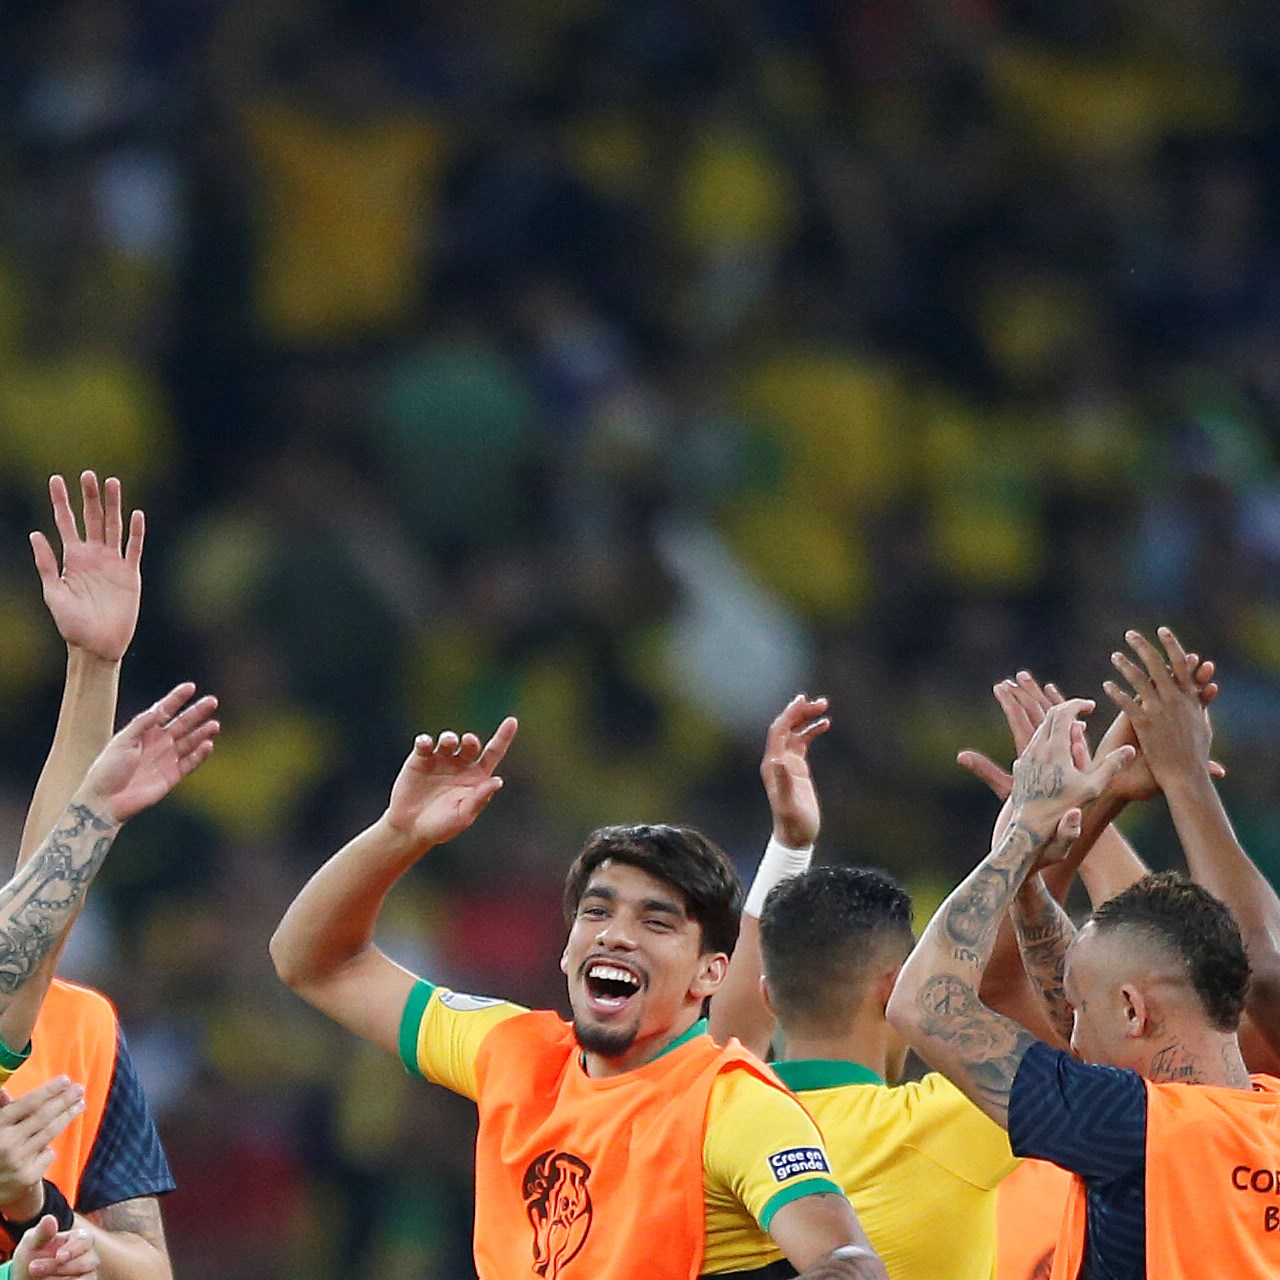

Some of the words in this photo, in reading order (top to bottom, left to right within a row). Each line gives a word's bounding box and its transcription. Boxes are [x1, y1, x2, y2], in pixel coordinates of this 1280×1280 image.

[771, 1151, 805, 1167] Cree
[805, 1151, 823, 1161] en
[776, 1159, 824, 1180] grande
